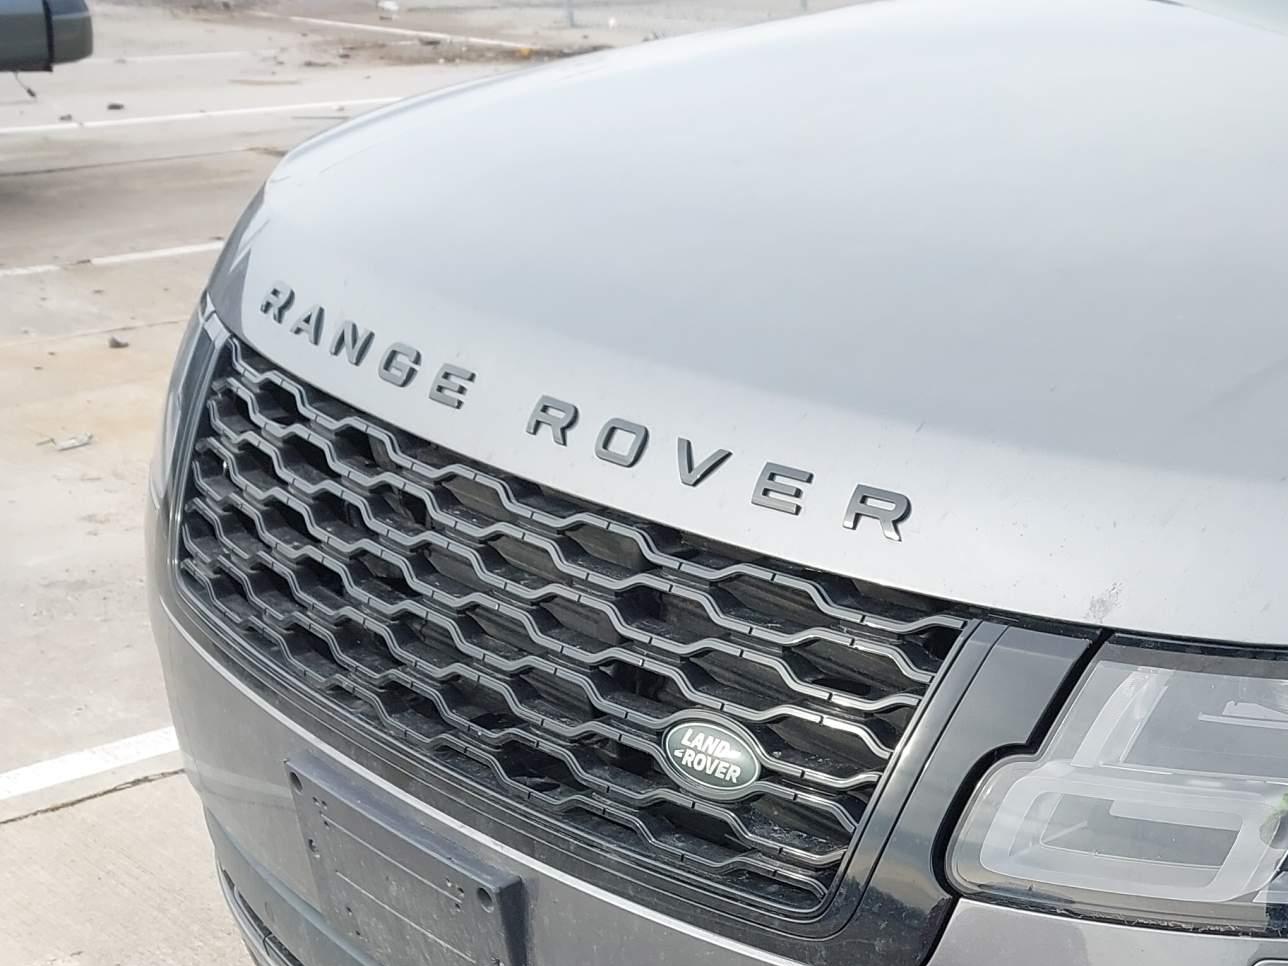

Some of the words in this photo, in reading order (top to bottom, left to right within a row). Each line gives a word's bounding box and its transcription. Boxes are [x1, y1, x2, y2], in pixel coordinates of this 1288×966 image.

[259, 279, 477, 409] RANGE
[525, 394, 913, 542] ROVER
[680, 727, 732, 759] LAND
[680, 747, 742, 784] ROVER
